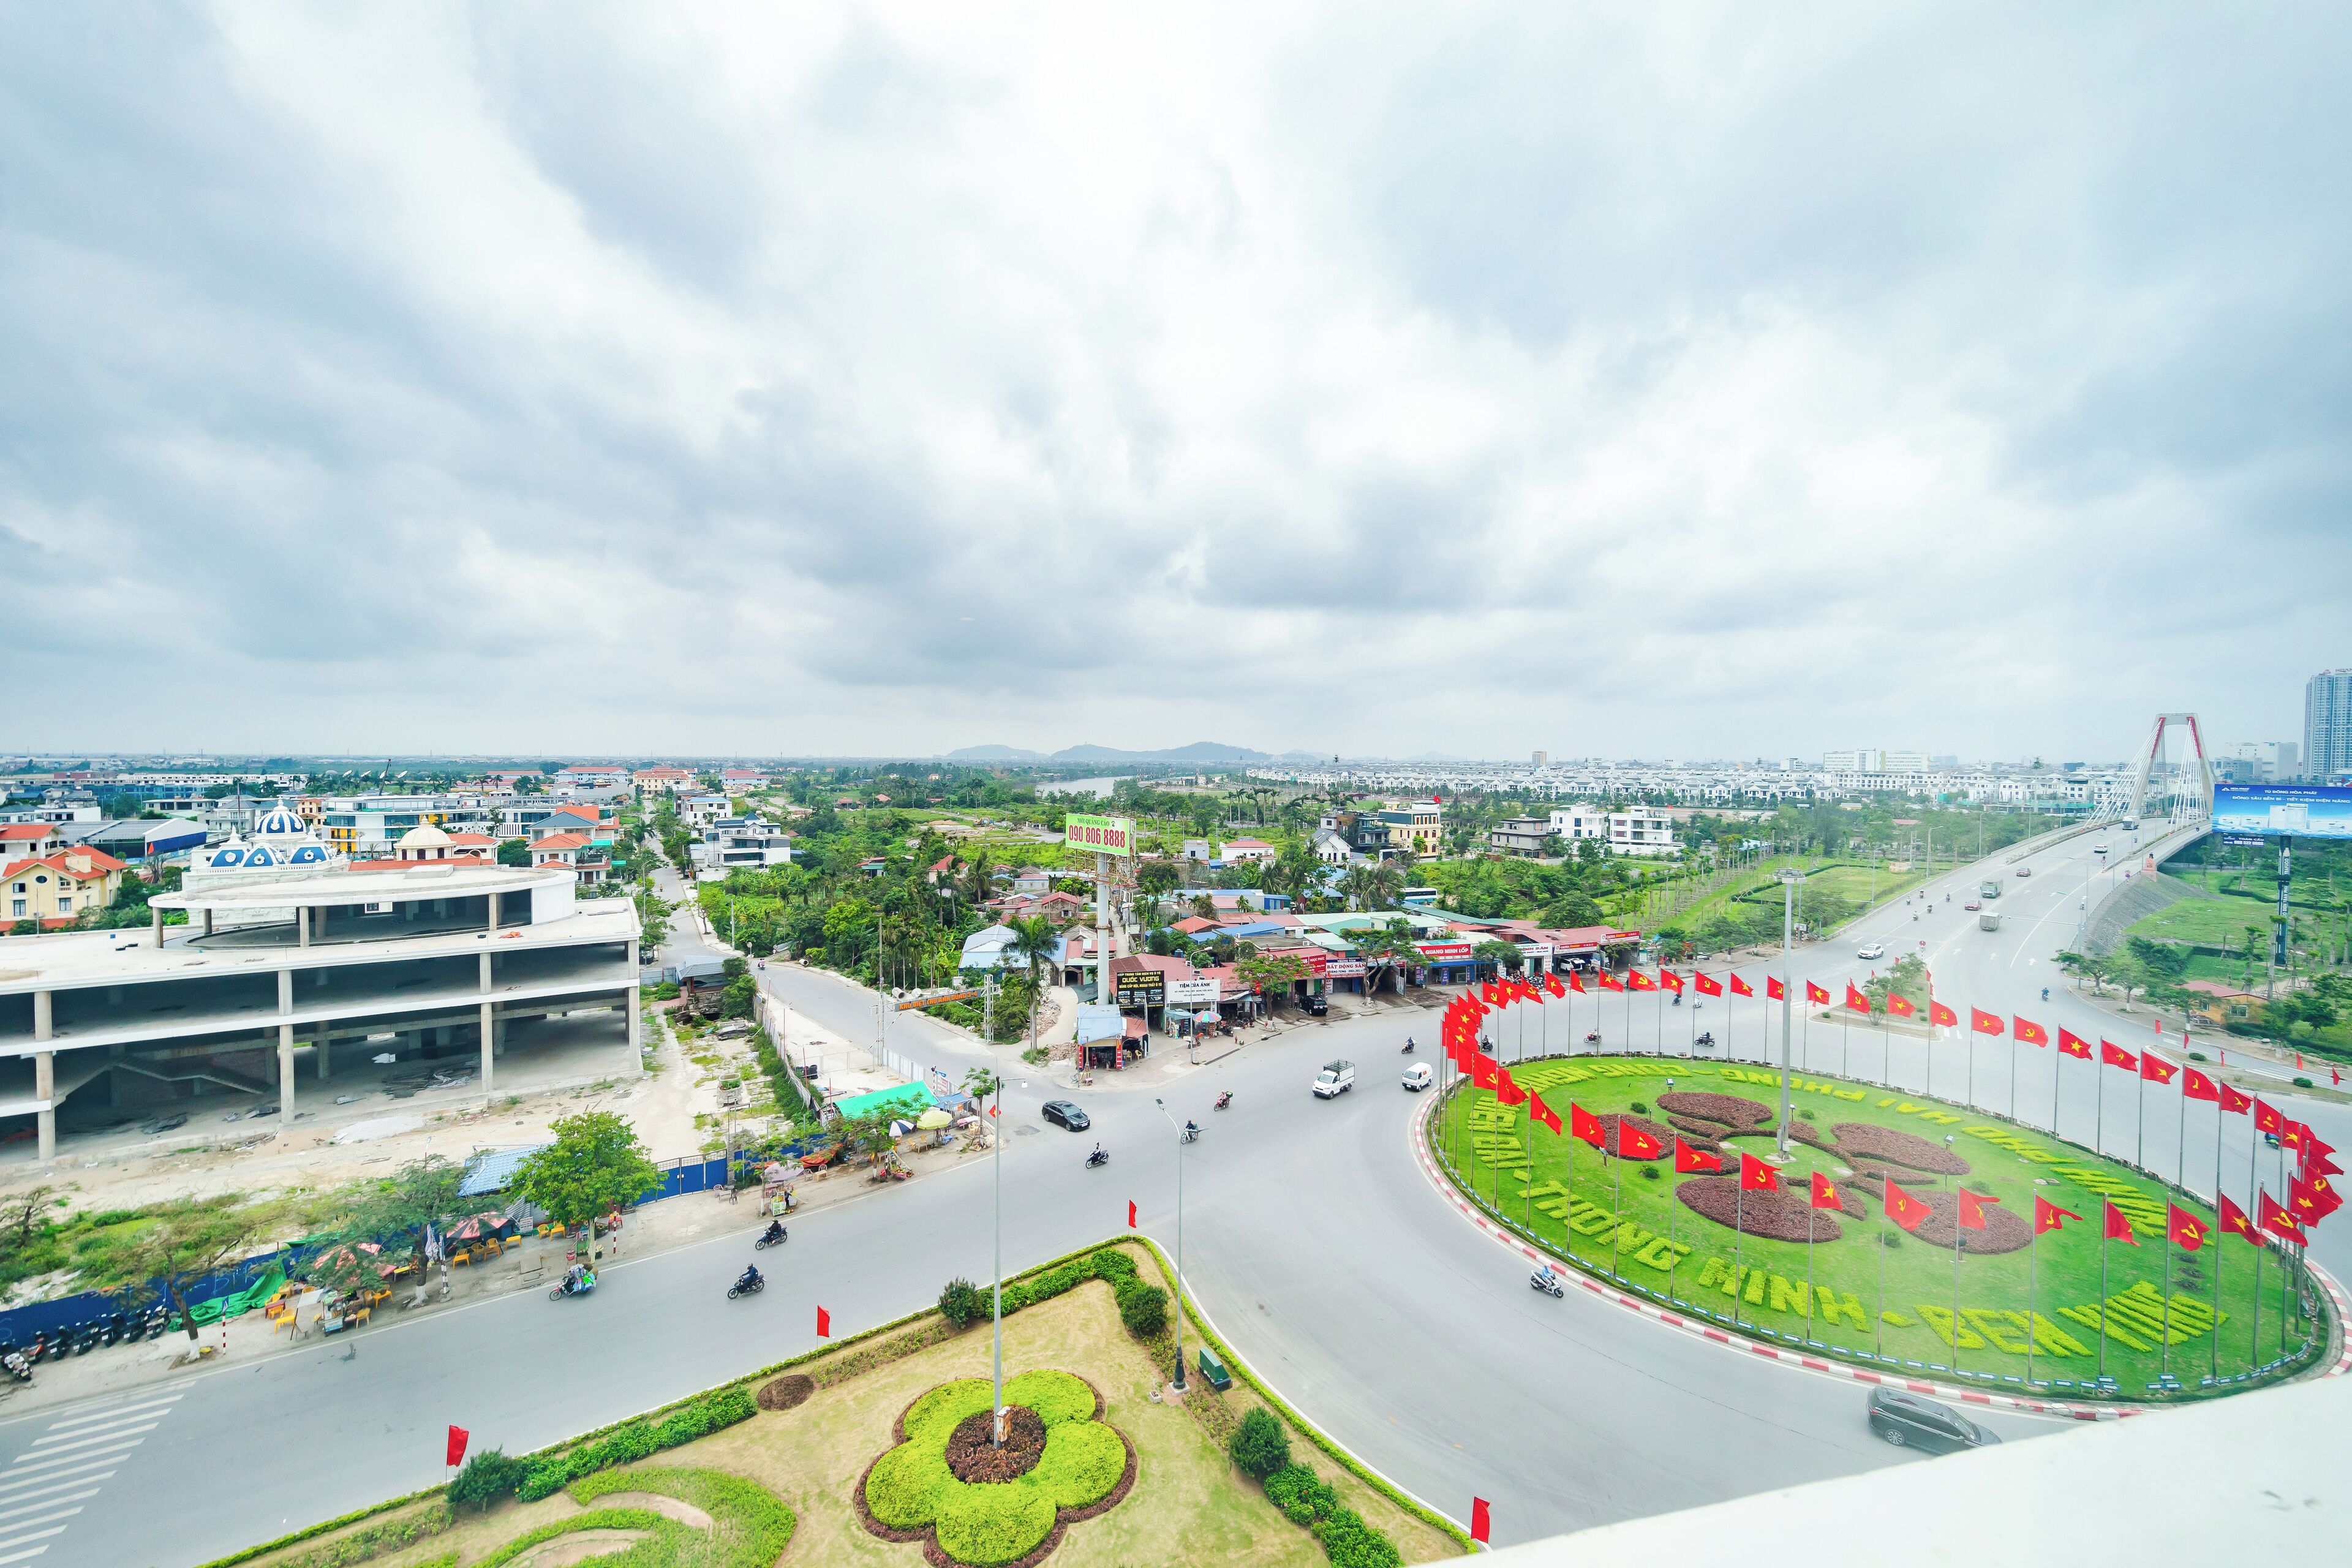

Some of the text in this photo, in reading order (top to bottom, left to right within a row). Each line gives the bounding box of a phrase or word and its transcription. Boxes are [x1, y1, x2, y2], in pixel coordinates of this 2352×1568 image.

[1069, 824, 1125, 848] 090 806 8888
[1717, 1068, 1866, 1102] PHONG
[1517, 1180, 1691, 1272] THONG
[1697, 1256, 1871, 1333] MINH
